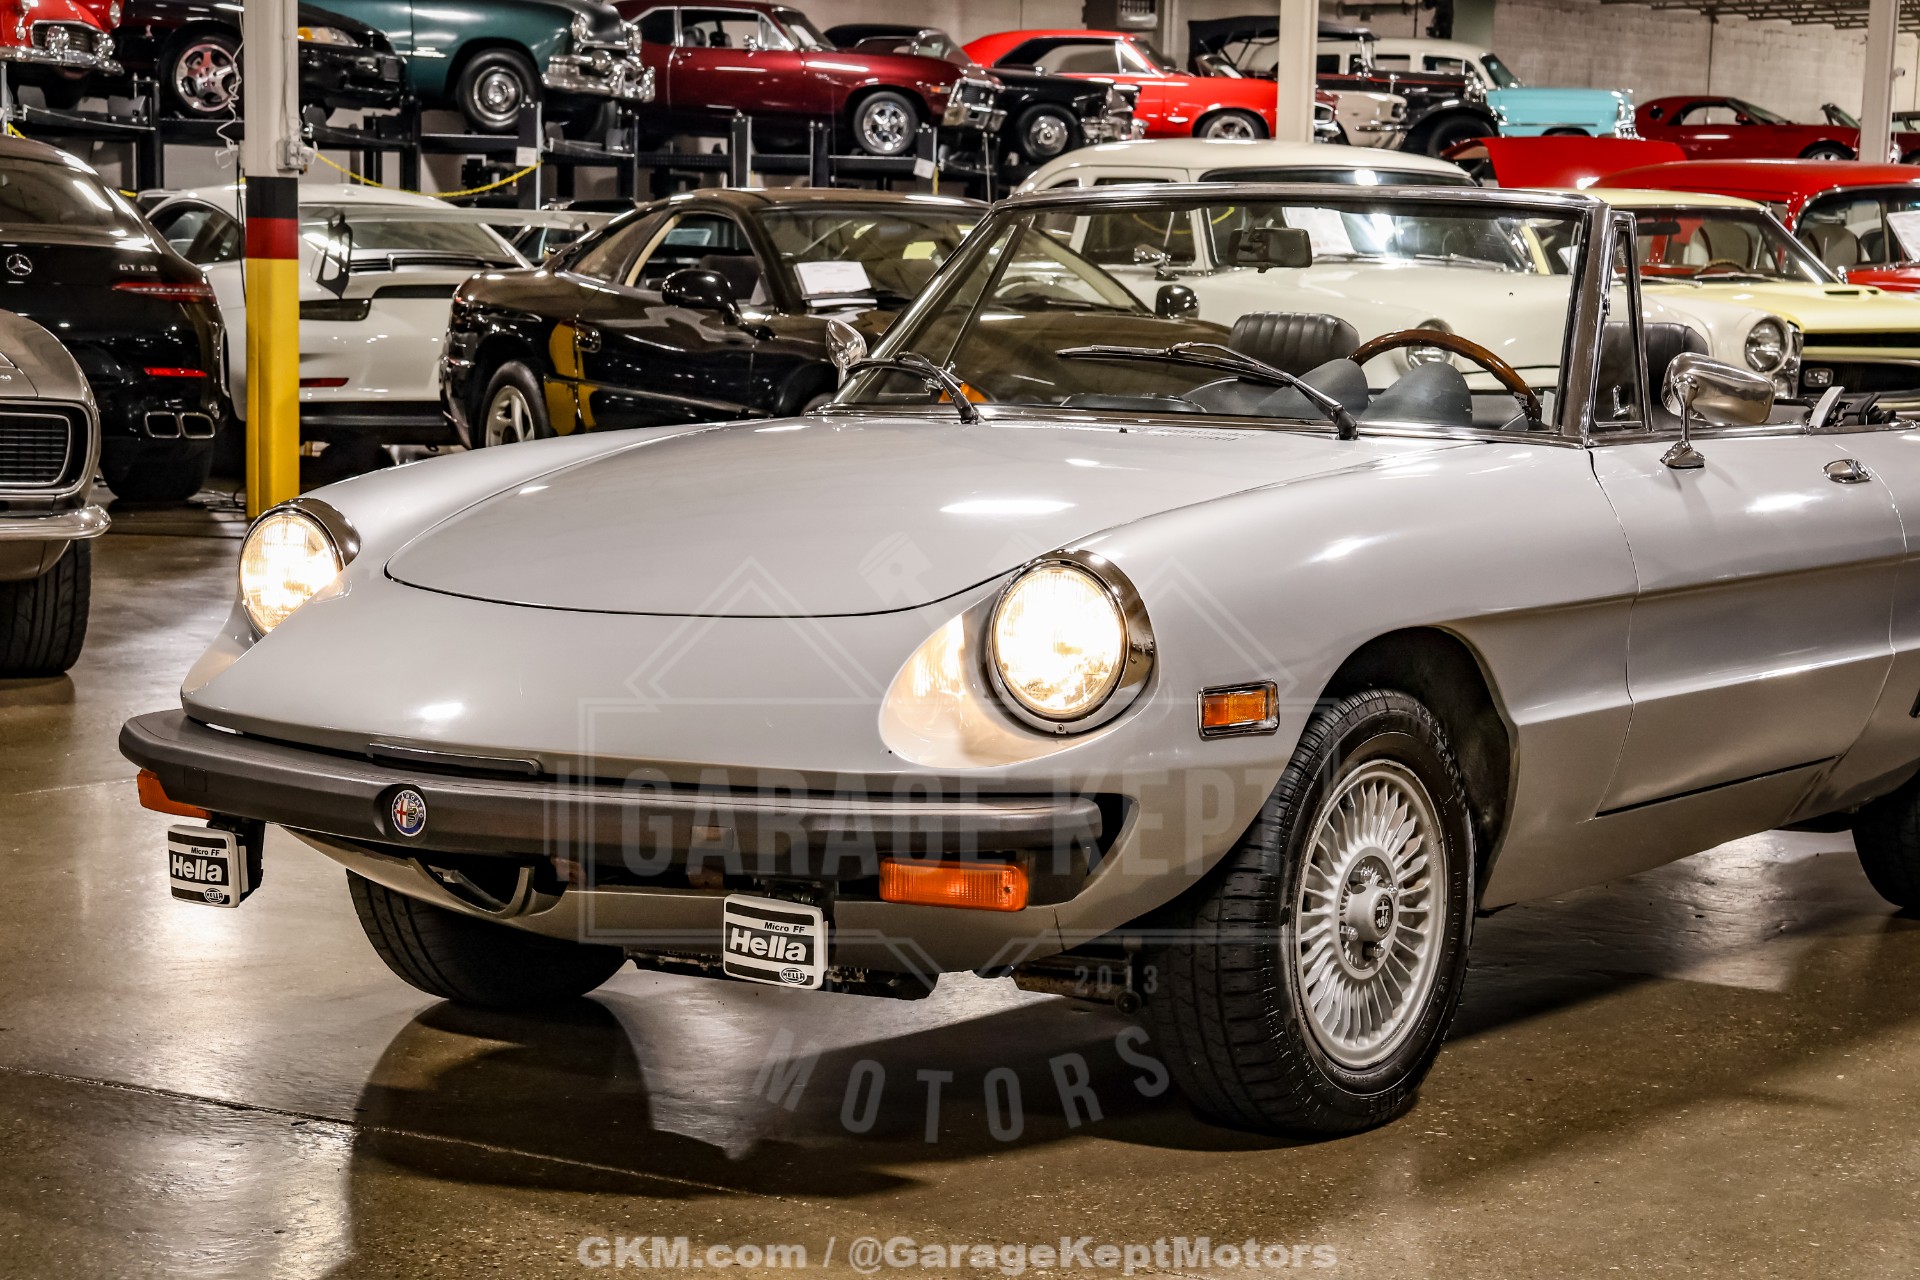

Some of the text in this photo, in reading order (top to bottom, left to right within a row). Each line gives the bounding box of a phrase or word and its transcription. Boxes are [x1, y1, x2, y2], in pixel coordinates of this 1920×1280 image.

[190, 847, 220, 857] Micro FF
[171, 853, 223, 882] Hella
[764, 921, 806, 934] Micro FF
[729, 927, 807, 962] Hella
[782, 969, 806, 981] HELLA
